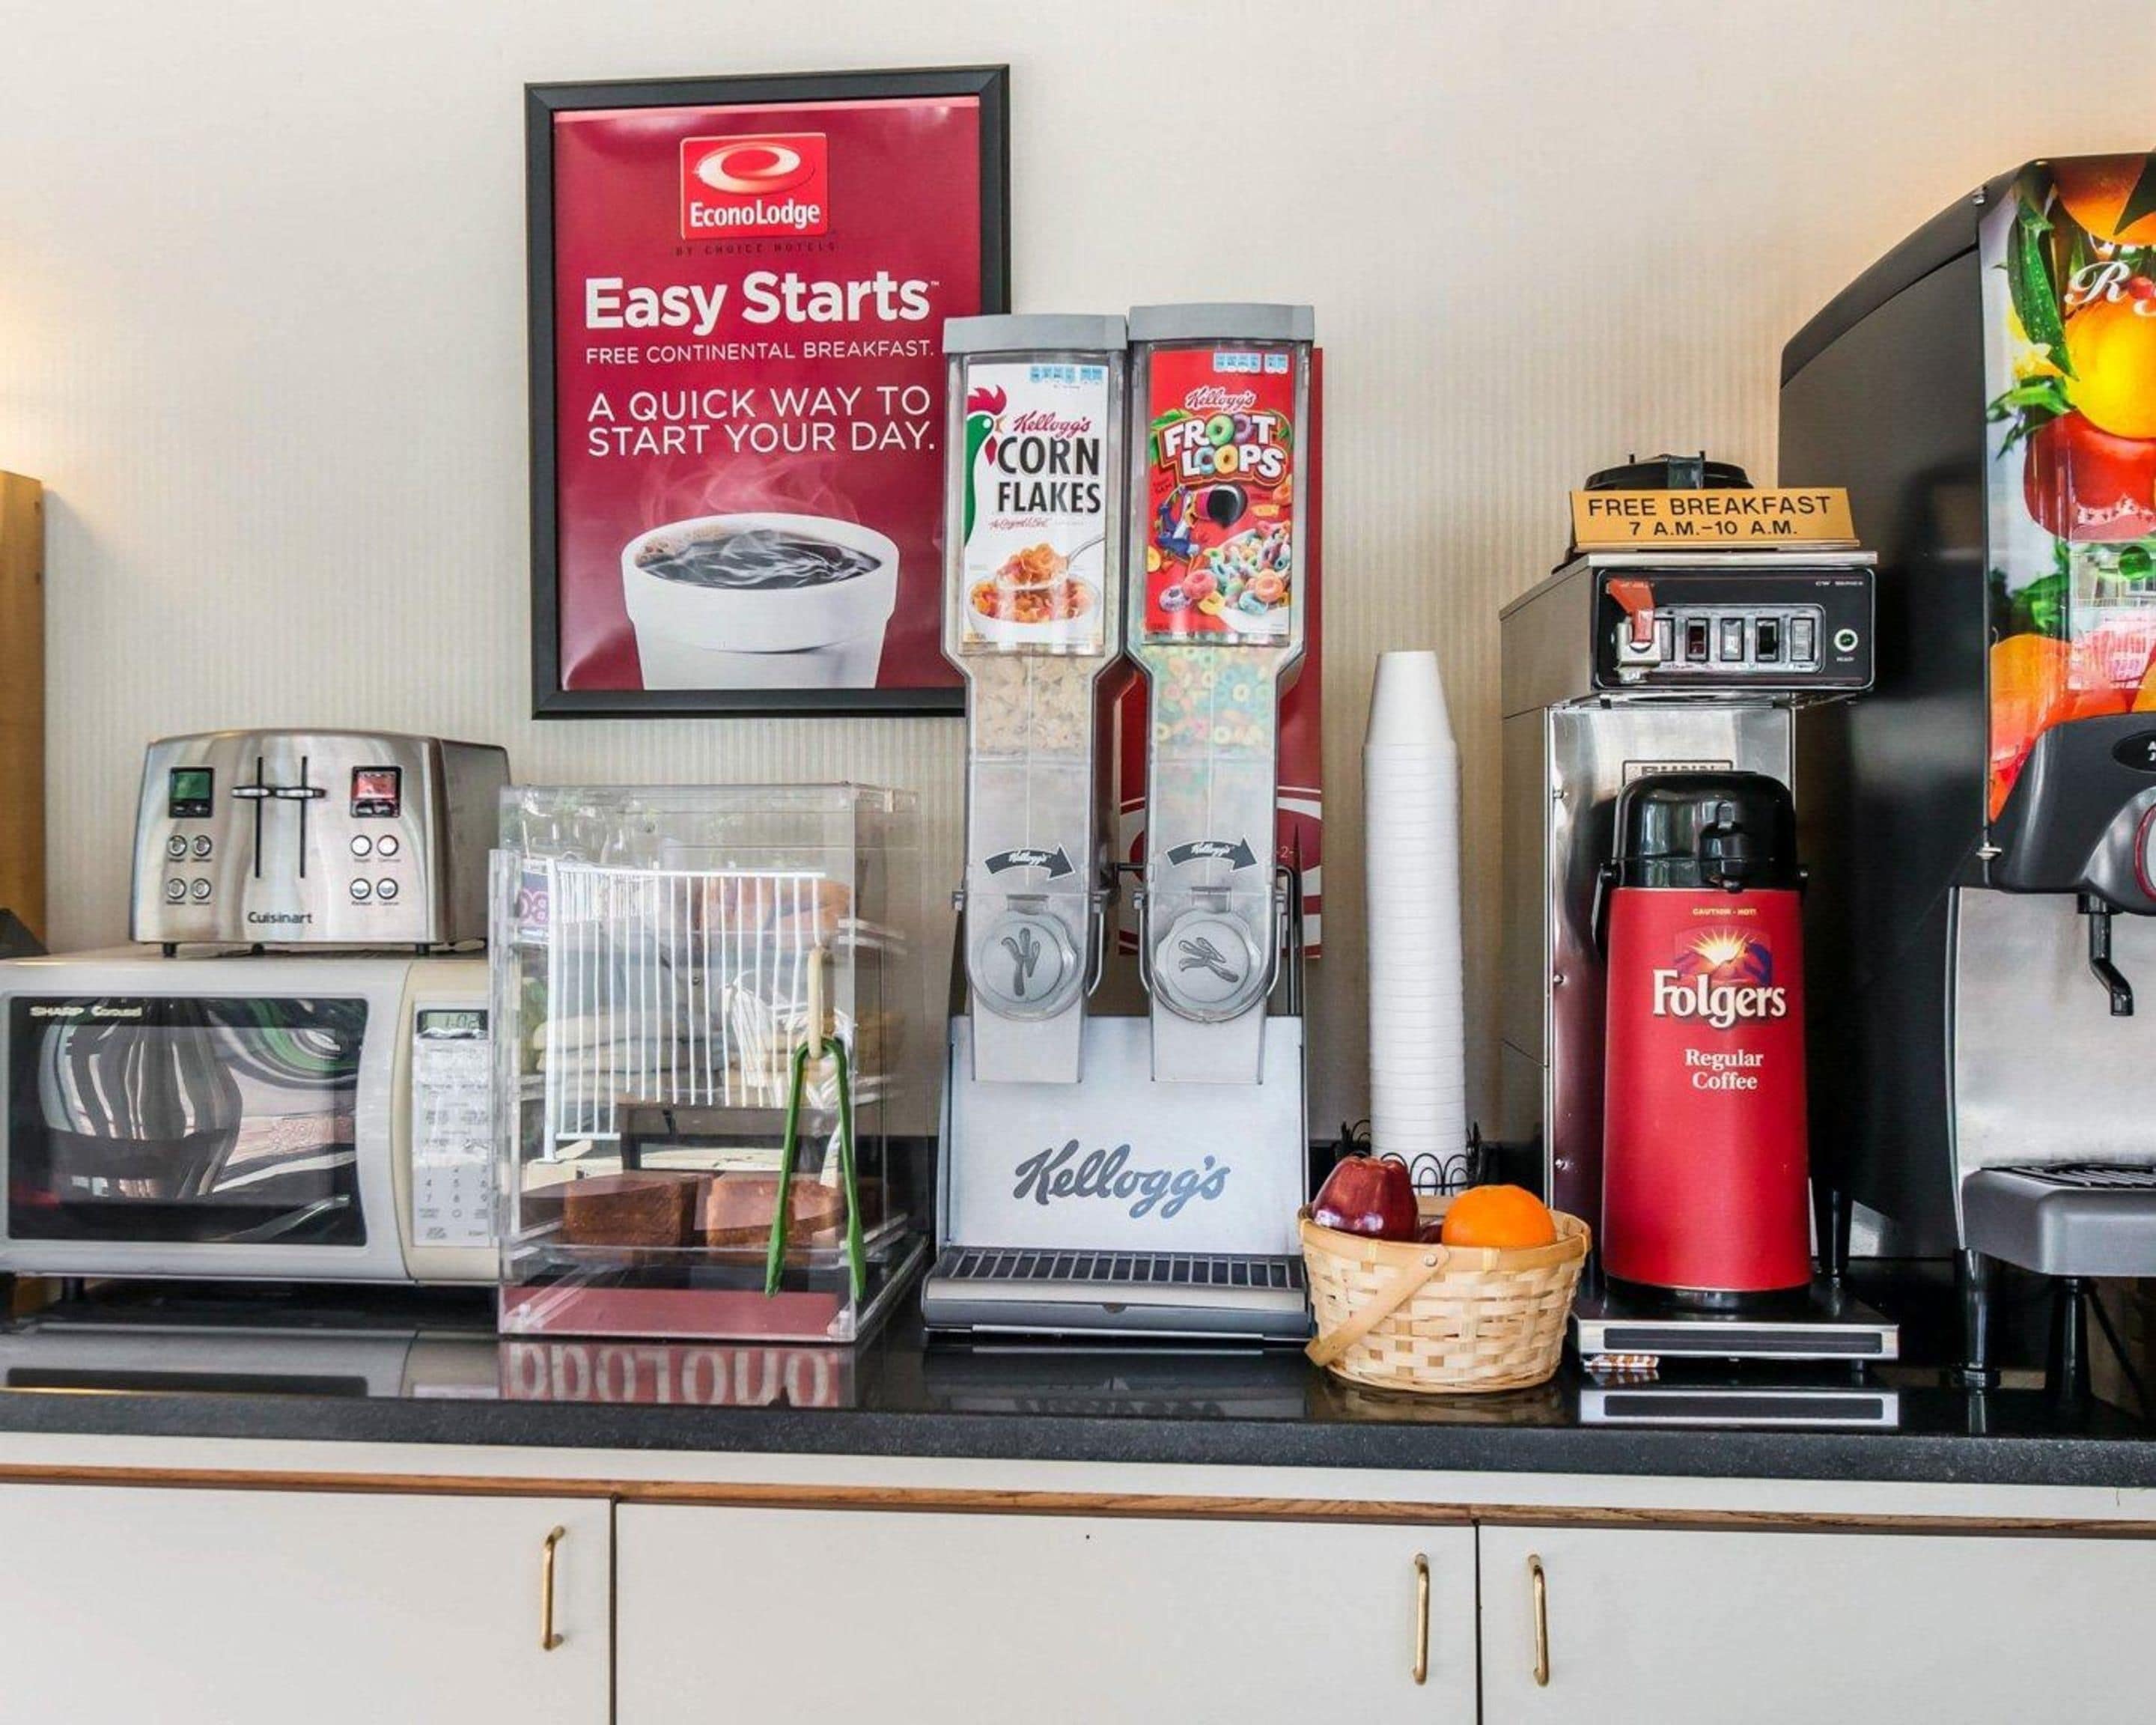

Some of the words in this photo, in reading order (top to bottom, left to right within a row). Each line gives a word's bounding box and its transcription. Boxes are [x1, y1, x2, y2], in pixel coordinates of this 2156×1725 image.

[689, 198, 820, 230] EconoLodge
[704, 243, 763, 255] CHOICE
[773, 242, 835, 253] HOTELS
[585, 276, 728, 336] Easy
[586, 347, 639, 365] FREE
[646, 343, 796, 364] CONTINENTAL
[803, 339, 934, 359] BREAKFAST.
[587, 392, 615, 422] A
[629, 389, 756, 422] QUICK
[769, 386, 862, 417] WAY
[876, 385, 931, 416] TO
[1186, 385, 1255, 411] Kellogg's
[588, 425, 710, 457] START
[724, 422, 836, 453] YOUR
[851, 421, 935, 451] DAY.
[1013, 410, 1092, 438] Kellogg's
[1163, 412, 1277, 458] FROOT
[997, 436, 1100, 475] CORN
[1181, 444, 1285, 478] LOOPS
[998, 481, 1101, 514] FLAKES
[1589, 498, 1657, 517] FREE
[1669, 496, 1831, 516] BREAKFAST
[1629, 521, 1641, 536] 7
[1750, 520, 1797, 535] A.M.
[246, 910, 312, 924] Cuisinart
[30, 1006, 85, 1017] SHARP
[1651, 968, 1787, 1029] Folgers
[1684, 1048, 1764, 1071] Regular
[1692, 1071, 1758, 1090] Coffee
[1012, 1138, 1231, 1220] Kellogg's
